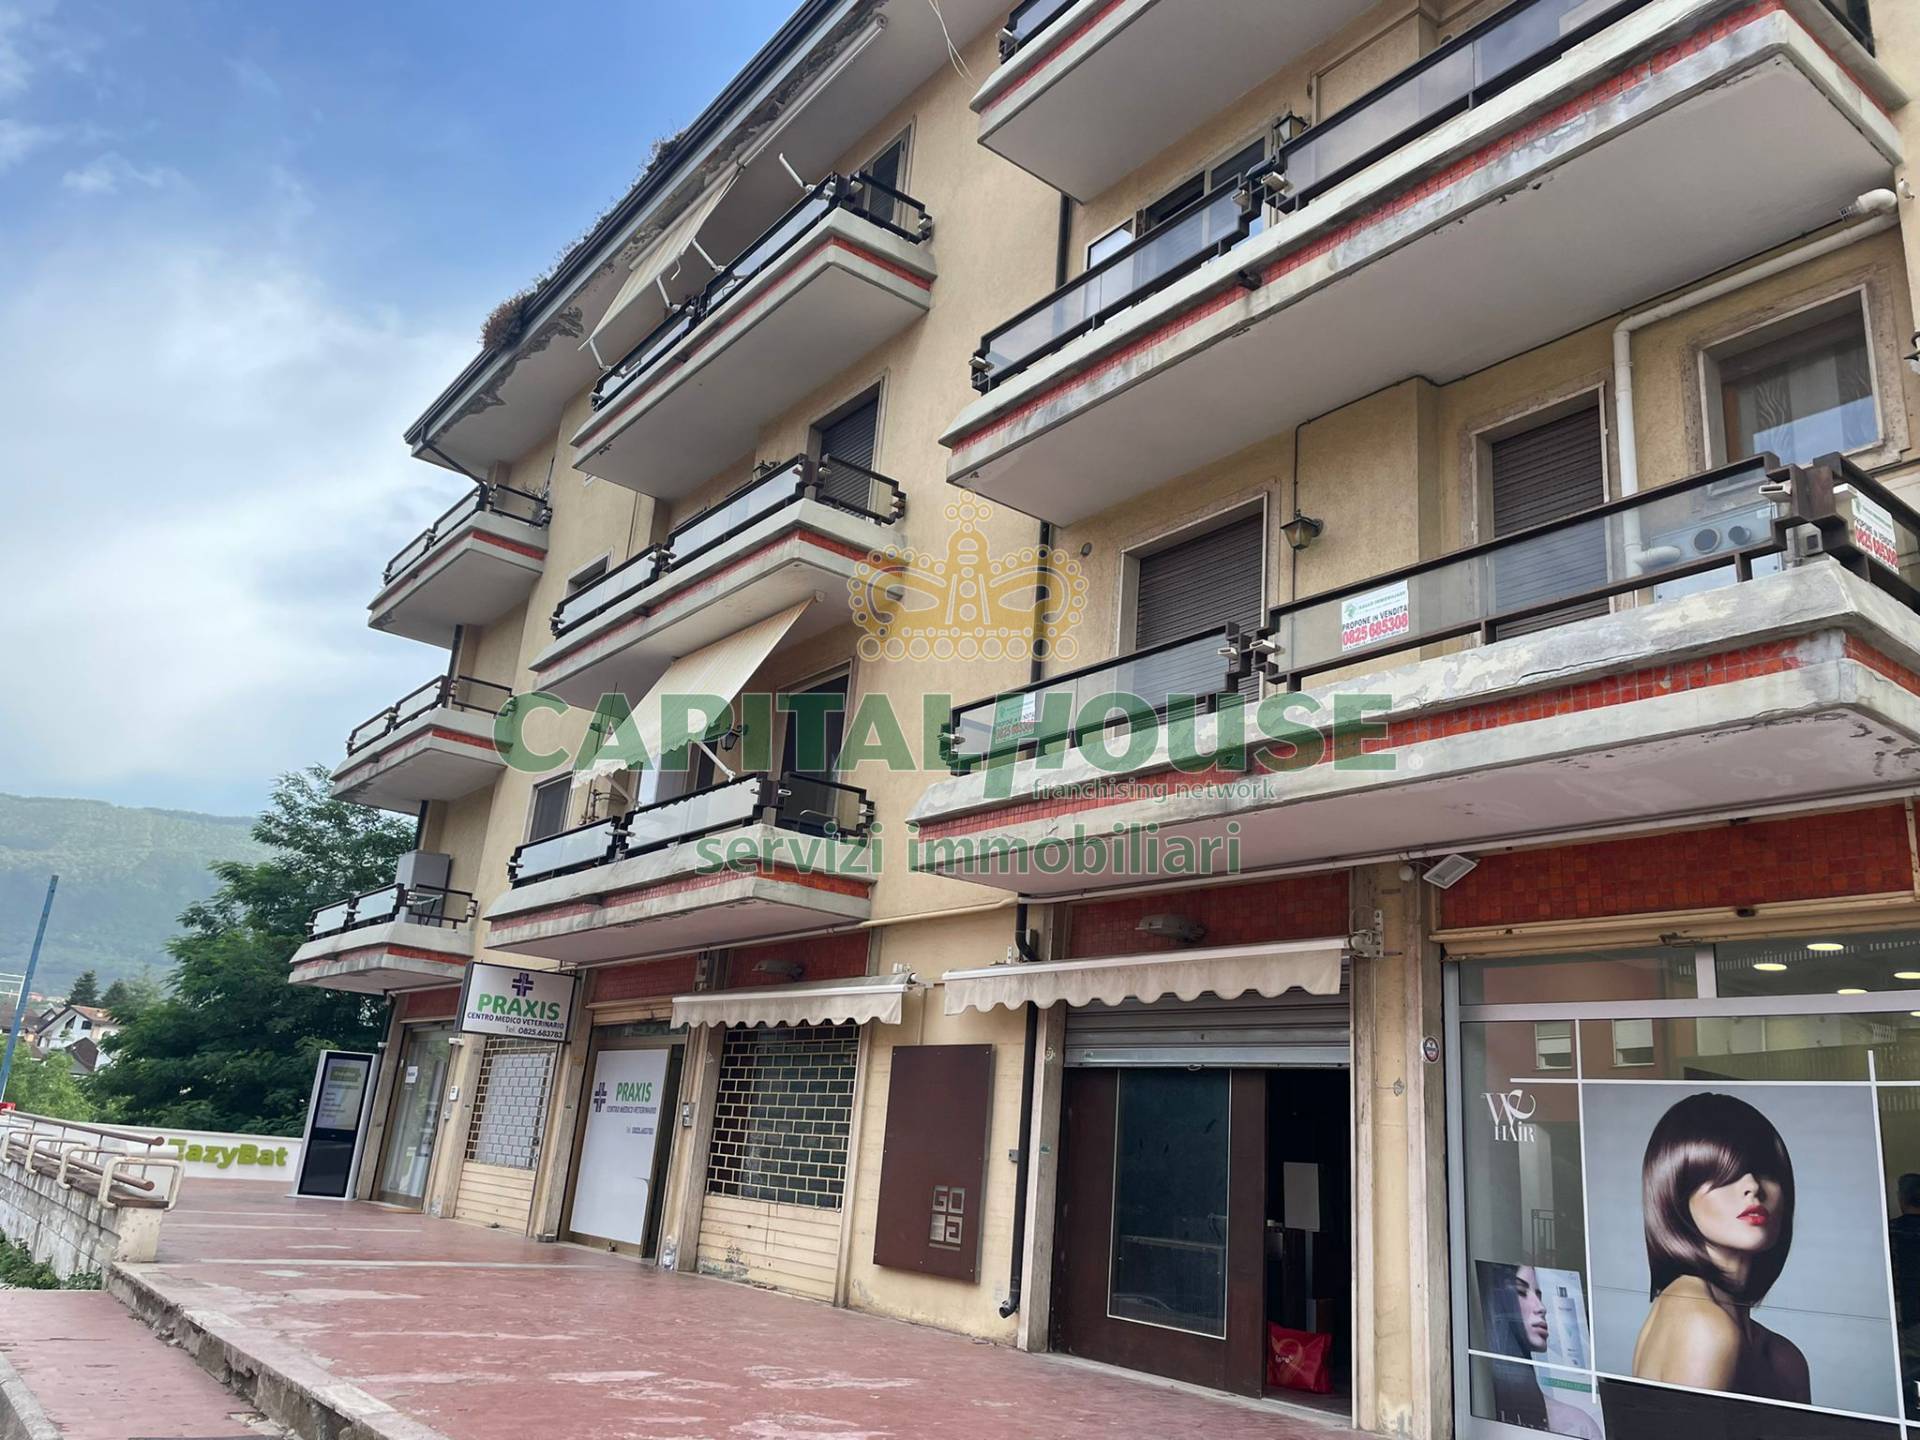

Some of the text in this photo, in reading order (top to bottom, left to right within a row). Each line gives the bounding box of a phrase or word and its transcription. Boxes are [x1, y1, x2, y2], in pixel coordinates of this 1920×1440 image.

[1343, 616, 1371, 630] PROPONE
[1379, 604, 1408, 619] VENDITA
[1343, 625, 1368, 646] 0825
[478, 993, 560, 1021] PRAXIS
[467, 1012, 565, 1029] CENTRO MEDICO VETERINARIO
[616, 1082, 652, 1103] PRAXIS
